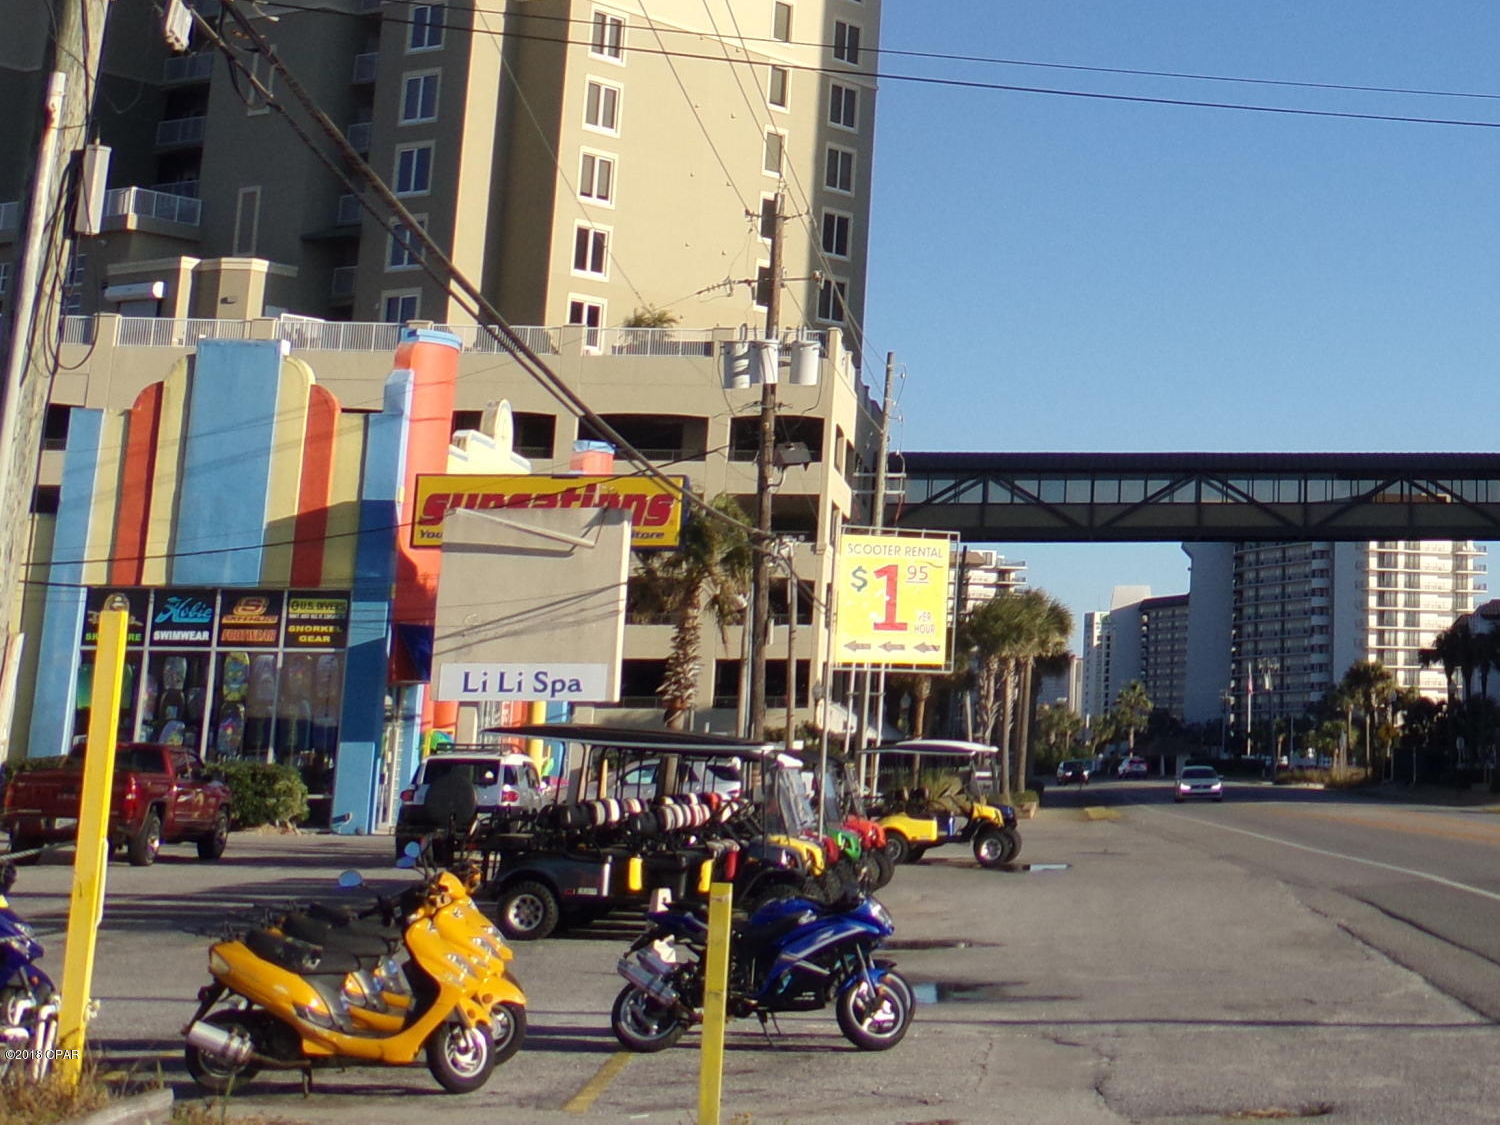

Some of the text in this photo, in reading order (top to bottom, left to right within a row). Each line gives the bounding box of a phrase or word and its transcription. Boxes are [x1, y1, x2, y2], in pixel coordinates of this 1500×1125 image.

[847, 543, 943, 558] SCOOTER RENTAL
[155, 597, 213, 623] Hobie
[288, 625, 344, 633] SNORKEL
[914, 624, 936, 636] HOUR
[153, 631, 210, 641] SWIMWEAR
[298, 635, 331, 643] GEAR
[462, 671, 582, 698] Li Li Spa
